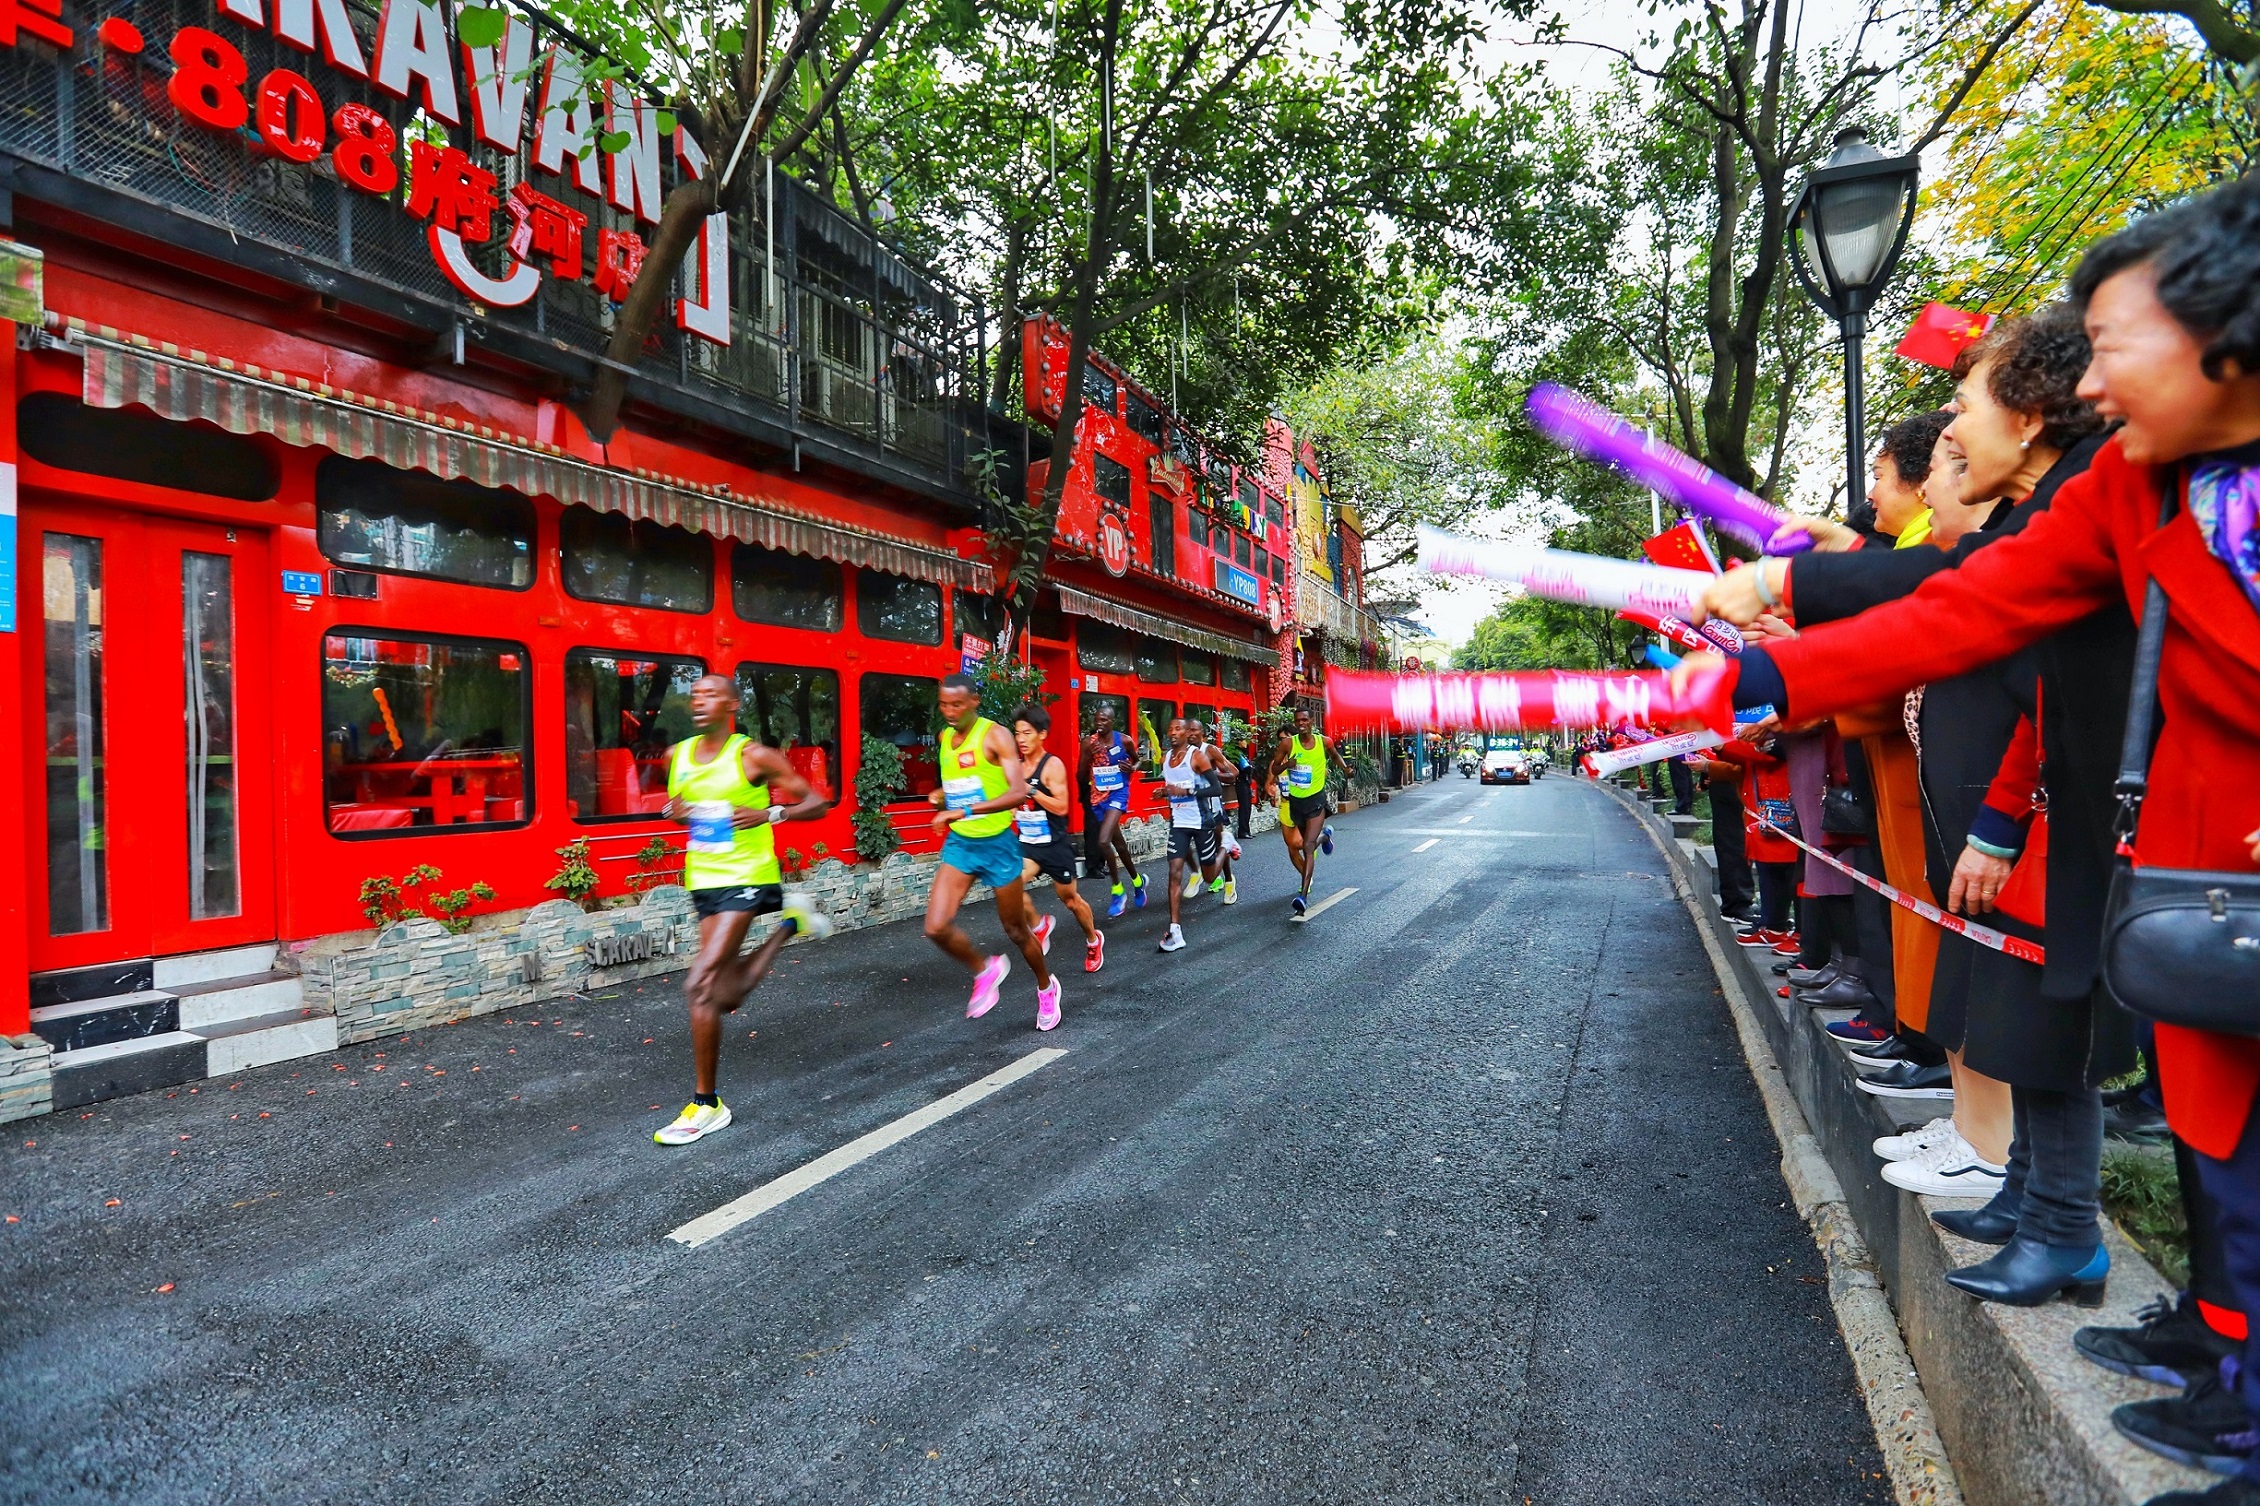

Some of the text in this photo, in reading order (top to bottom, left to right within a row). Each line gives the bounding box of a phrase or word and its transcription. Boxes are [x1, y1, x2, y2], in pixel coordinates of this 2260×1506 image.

[1104, 525, 1124, 561] YP
[1269, 600, 1279, 623] YP
[1714, 621, 1740, 640] 百岁山
